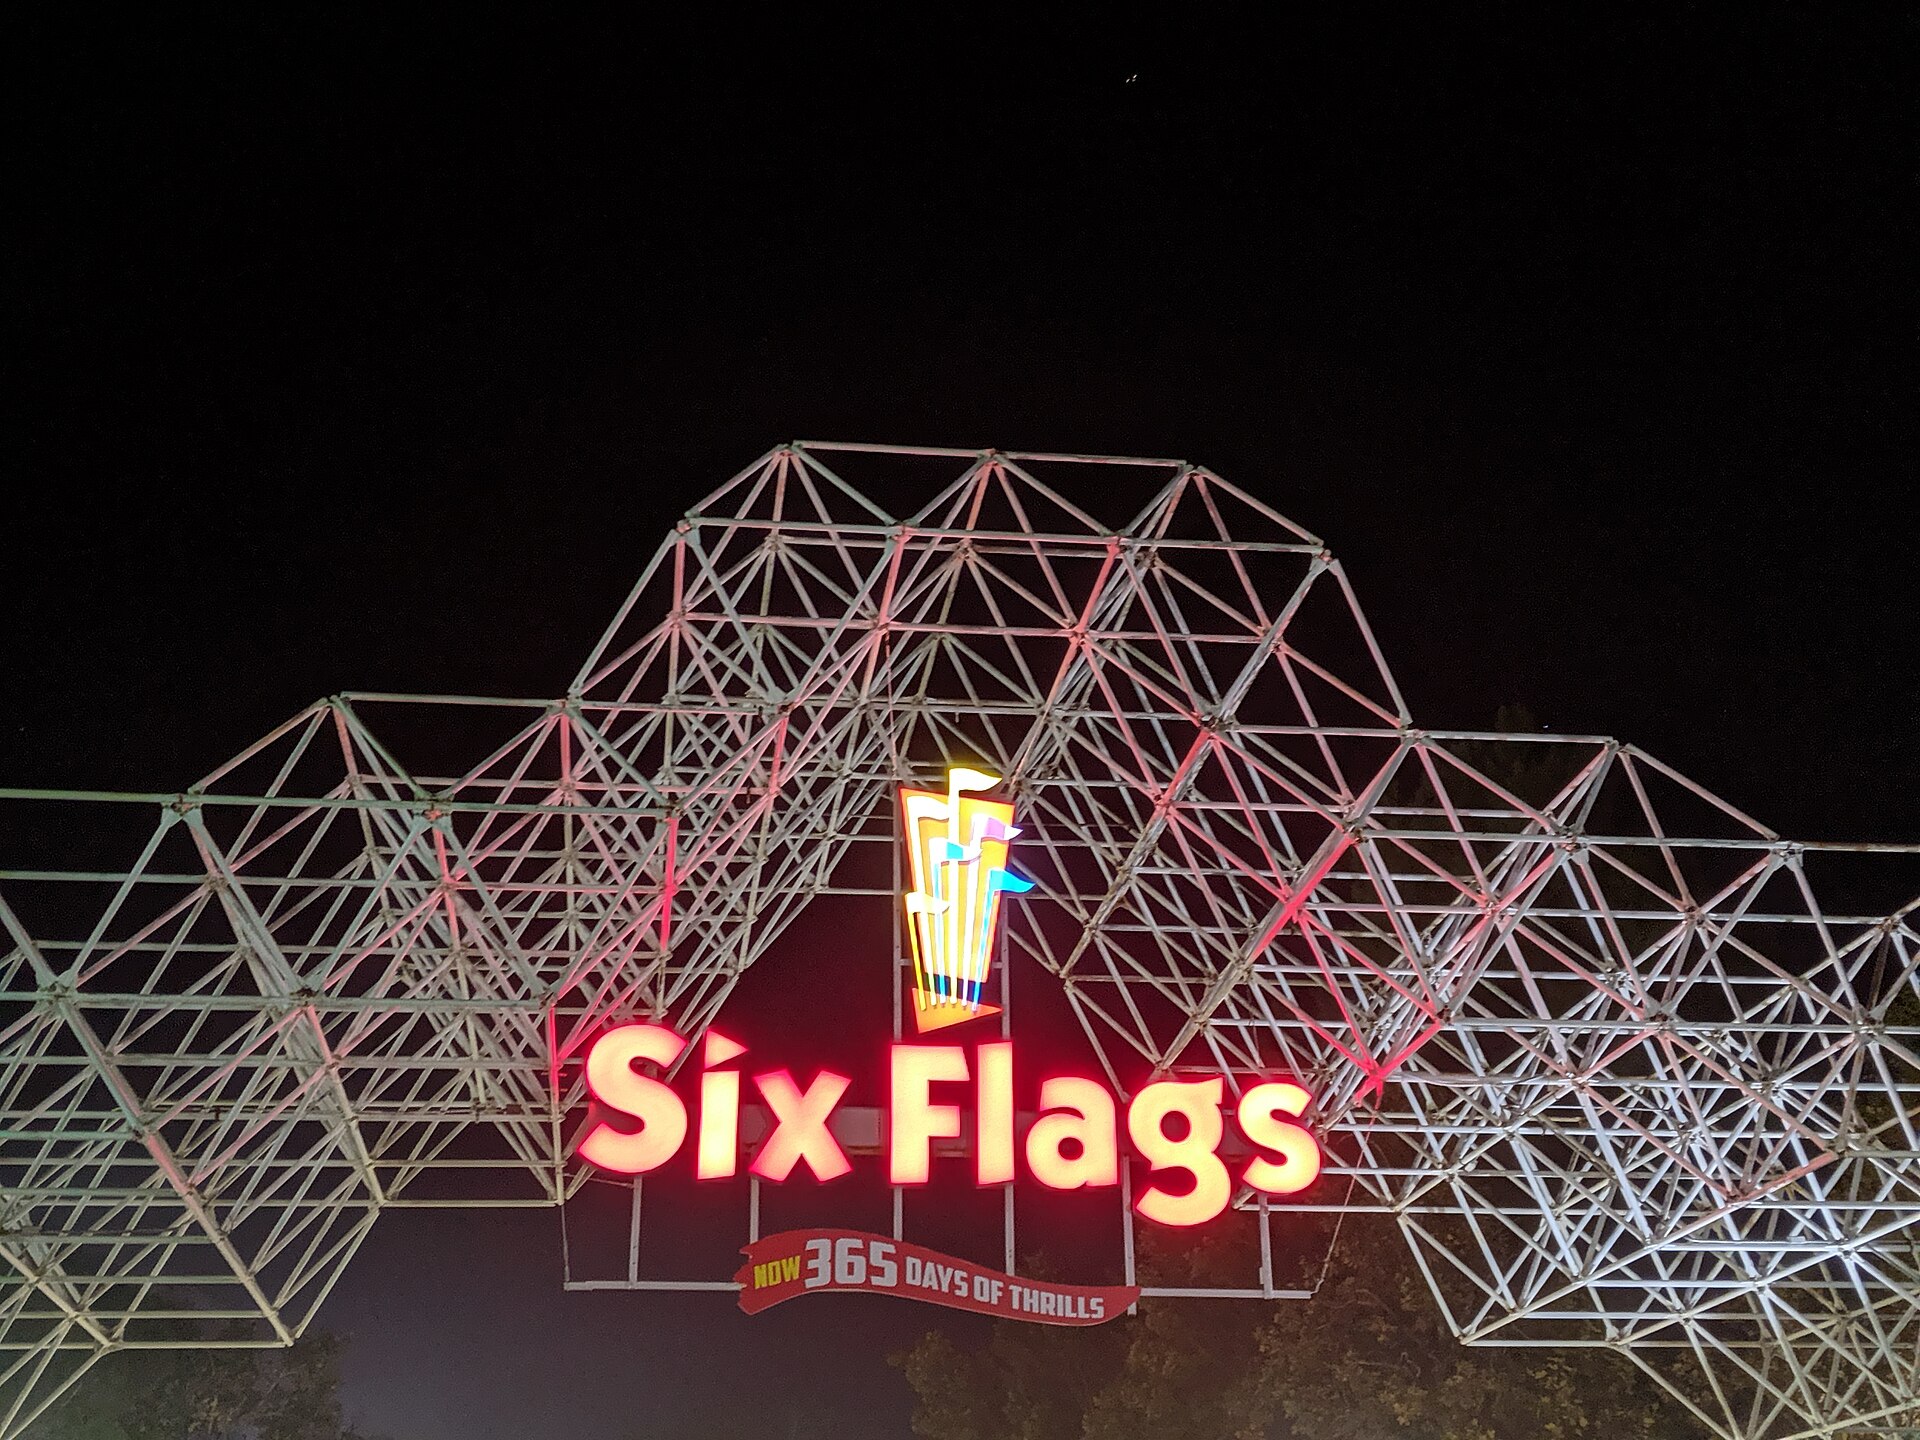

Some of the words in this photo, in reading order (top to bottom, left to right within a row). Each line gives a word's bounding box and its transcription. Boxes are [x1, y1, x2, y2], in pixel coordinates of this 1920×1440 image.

[577, 1024, 854, 1183] Six
[889, 1041, 1322, 1226] Flags
[754, 1255, 801, 1290] NOW
[804, 1238, 898, 1289] 365
[905, 1257, 969, 1297] DAYS
[973, 1276, 1004, 1304] OF
[1008, 1285, 1105, 1320] THRILLS
